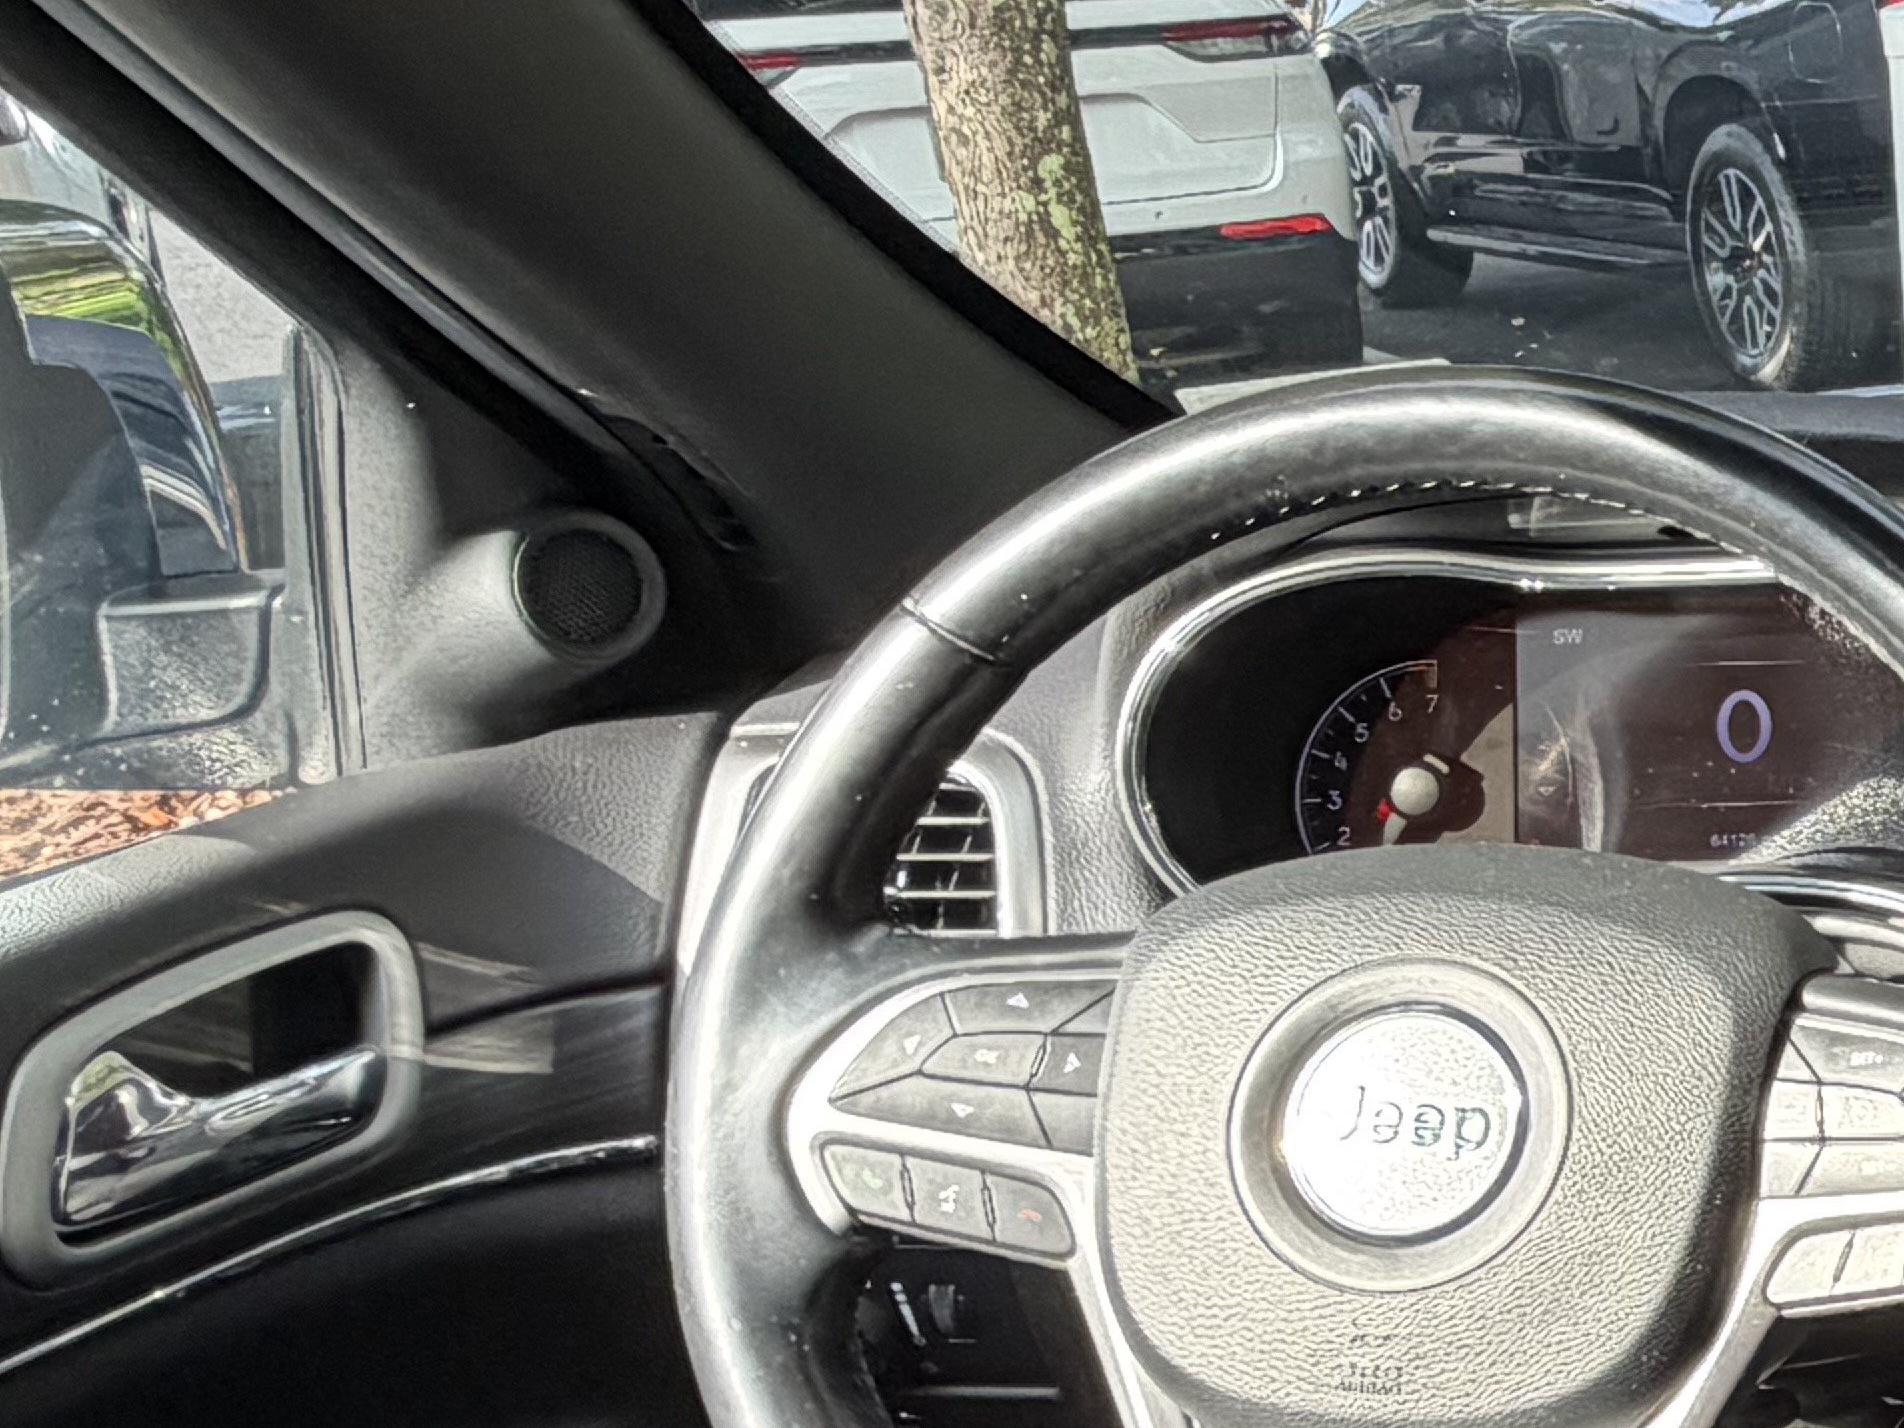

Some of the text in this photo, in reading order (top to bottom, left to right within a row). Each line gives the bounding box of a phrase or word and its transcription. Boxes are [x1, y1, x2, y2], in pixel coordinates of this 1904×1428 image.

[1553, 628, 1583, 645] SW
[1388, 702, 1402, 722] 6
[1425, 694, 1439, 714] 7
[1354, 723, 1370, 743] 5
[1716, 689, 1773, 763] 0
[1326, 790, 1343, 810] 3
[1337, 826, 1351, 846] 2
[1339, 1084, 1493, 1162] Jeep
